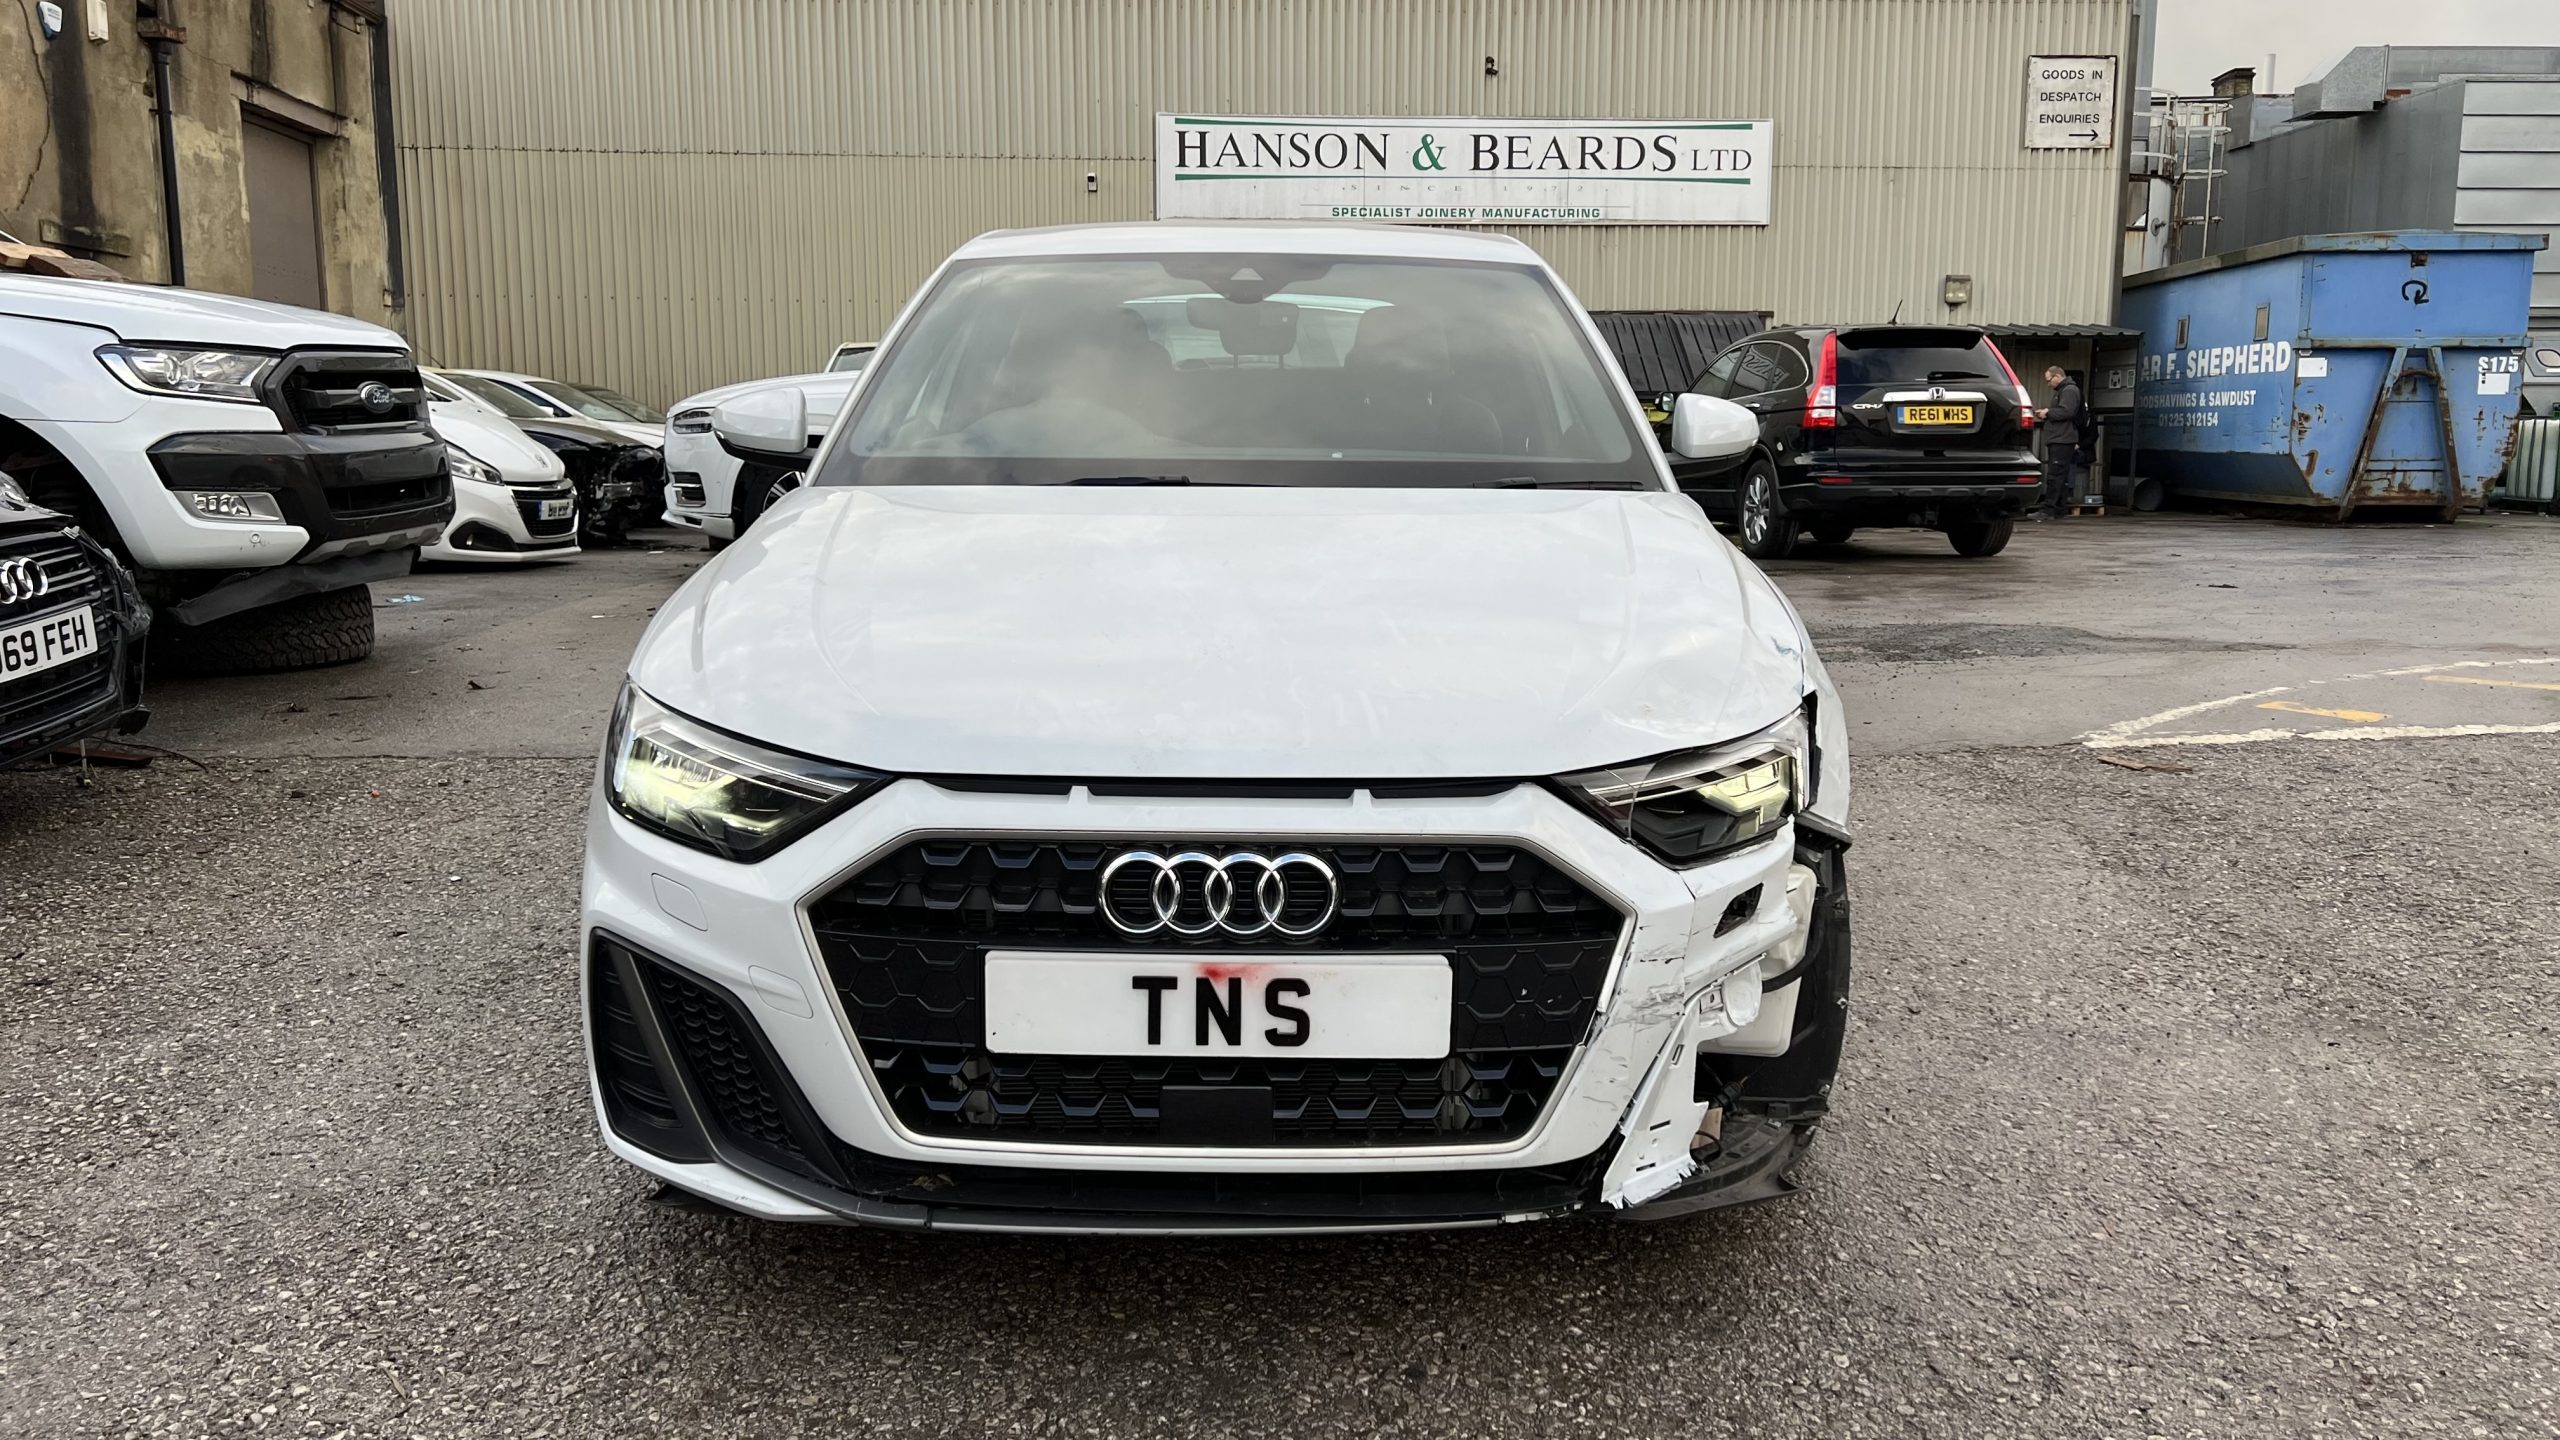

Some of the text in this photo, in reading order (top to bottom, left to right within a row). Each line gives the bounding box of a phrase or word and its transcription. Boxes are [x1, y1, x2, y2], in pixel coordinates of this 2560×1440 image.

[2042, 70, 2103, 80] GOODS IN
[2040, 92, 2102, 102] DESPATCH
[2039, 114, 2100, 124] ENQUIRIES
[1175, 130, 1752, 172] HANSON & BEARDS LTD
[1332, 207, 1600, 218] SPECIALIST JOINERY MANUFACTURING
[2166, 352, 2181, 380] F.
[2186, 341, 2291, 379] SHEPHERD
[2478, 356, 2519, 373] S175
[372, 387, 390, 404] Ford
[2200, 391, 2207, 407] &
[2208, 389, 2257, 407] SAWDUST
[1909, 408, 1969, 421] RE61 WHS
[2186, 411, 2219, 427] 312154
[0, 614, 88, 675] 69 FEH
[1132, 975, 1311, 1047] TNS
